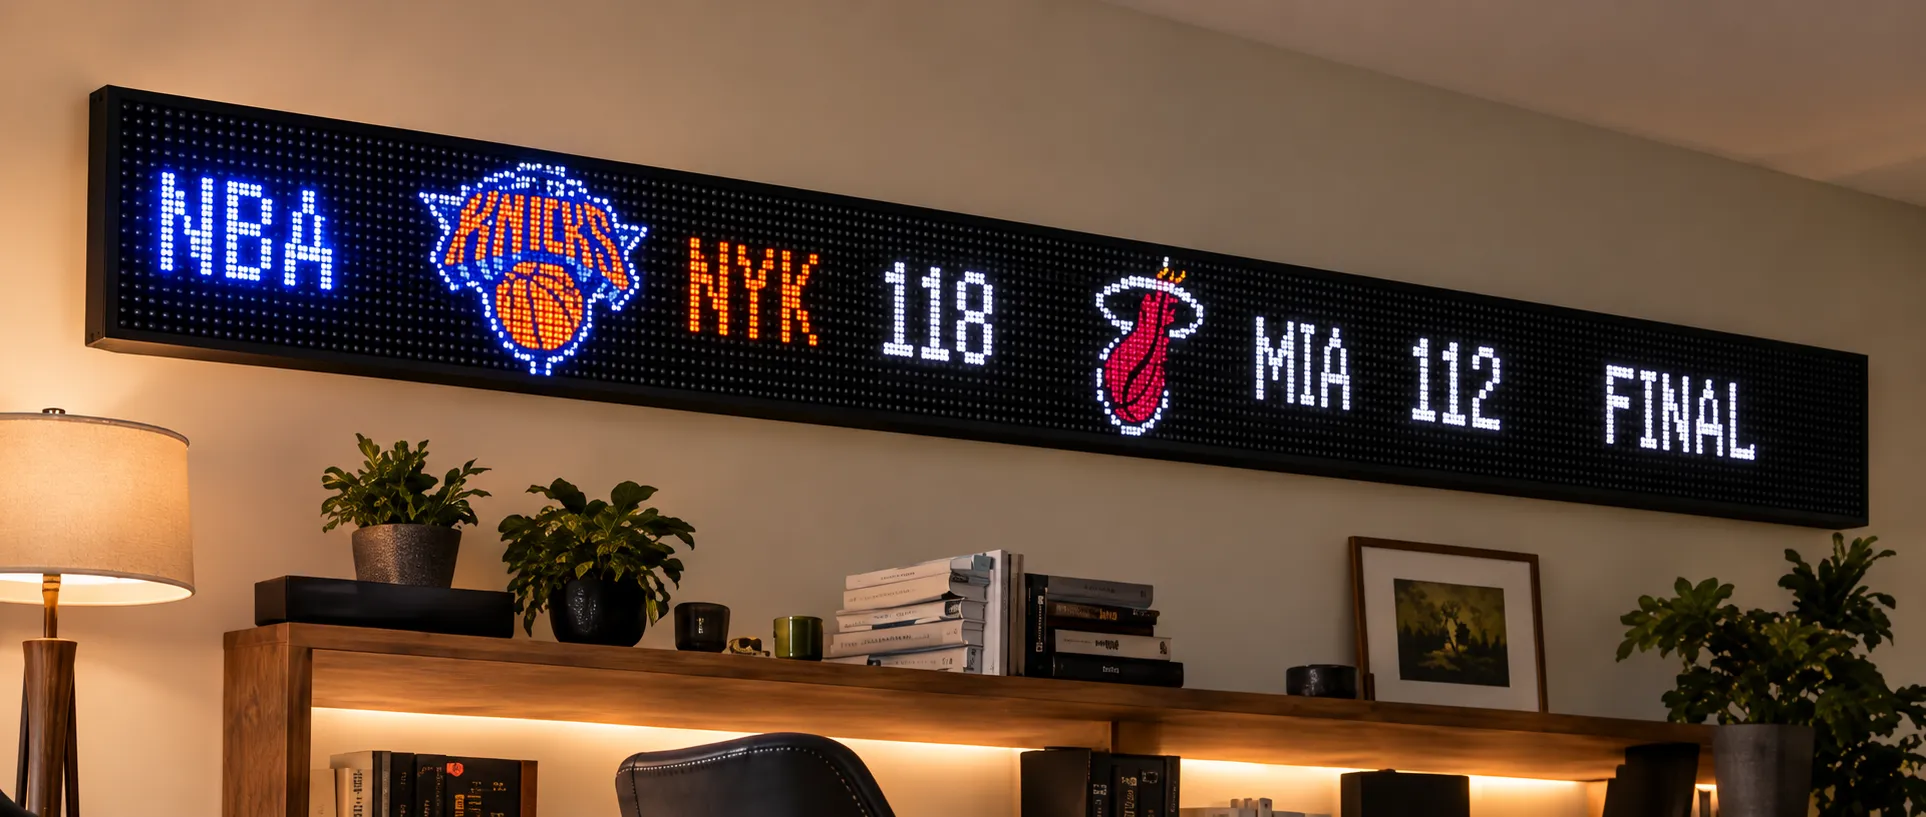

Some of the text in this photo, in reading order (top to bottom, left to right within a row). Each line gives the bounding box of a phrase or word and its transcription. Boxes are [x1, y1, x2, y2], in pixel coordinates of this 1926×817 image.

[159, 171, 1755, 460] NBA NYK 118 MIA 112 FINAL
[444, 190, 630, 290] KNICKS
